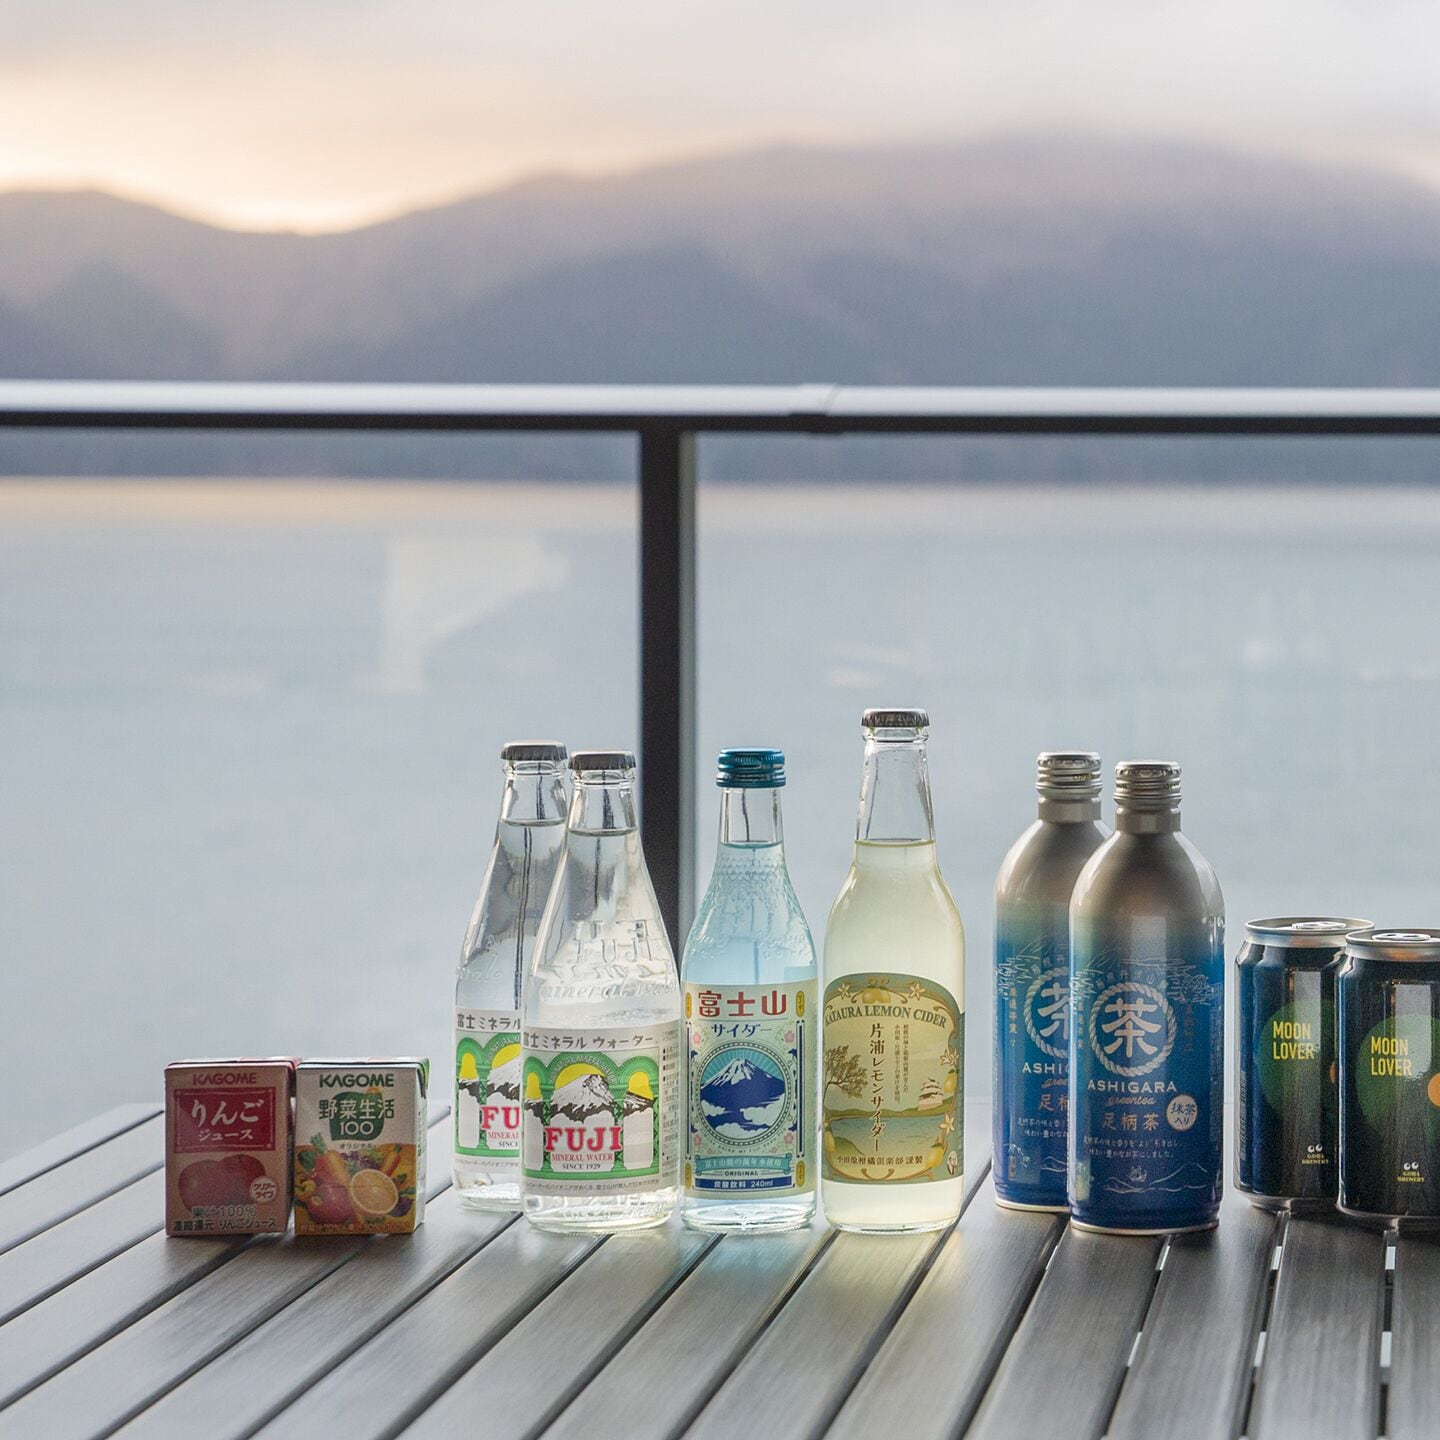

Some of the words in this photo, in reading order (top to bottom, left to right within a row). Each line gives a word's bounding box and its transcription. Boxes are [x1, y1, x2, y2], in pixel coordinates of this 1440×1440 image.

[698, 990, 787, 1018] 富士山
[864, 1005, 912, 1019] LEMON
[913, 1008, 948, 1028] CIDER
[711, 1023, 772, 1038] サイダー
[1102, 997, 1162, 1058] 茶
[1273, 1020, 1311, 1039] MOON
[592, 1035, 654, 1049] ウォーター
[1273, 1042, 1315, 1059] LOVER
[1371, 1036, 1408, 1056] MOON
[1371, 1057, 1413, 1076] LOVER
[192, 1073, 257, 1085] KAGOME
[319, 1074, 394, 1087] KAGOME
[869, 1023, 885, 1152] 片浦レモンサイダー
[1087, 1080, 1177, 1094] ASHIGARA
[191, 1099, 264, 1128] りんご
[318, 1099, 395, 1120] 野菜生活
[1170, 1103, 1196, 1115] 抹茶
[339, 1121, 375, 1136] 100
[1103, 1112, 1160, 1131] 足柄茶
[197, 1128, 254, 1142] ジュース
[544, 1127, 623, 1151] FUJI
[552, 1153, 585, 1162] MINERAL
[586, 1153, 614, 1161] WATER
[714, 1181, 747, 1189] 炭酸飲料
[750, 1180, 774, 1188] 240ml
[219, 1217, 277, 1230] りんごジュース
